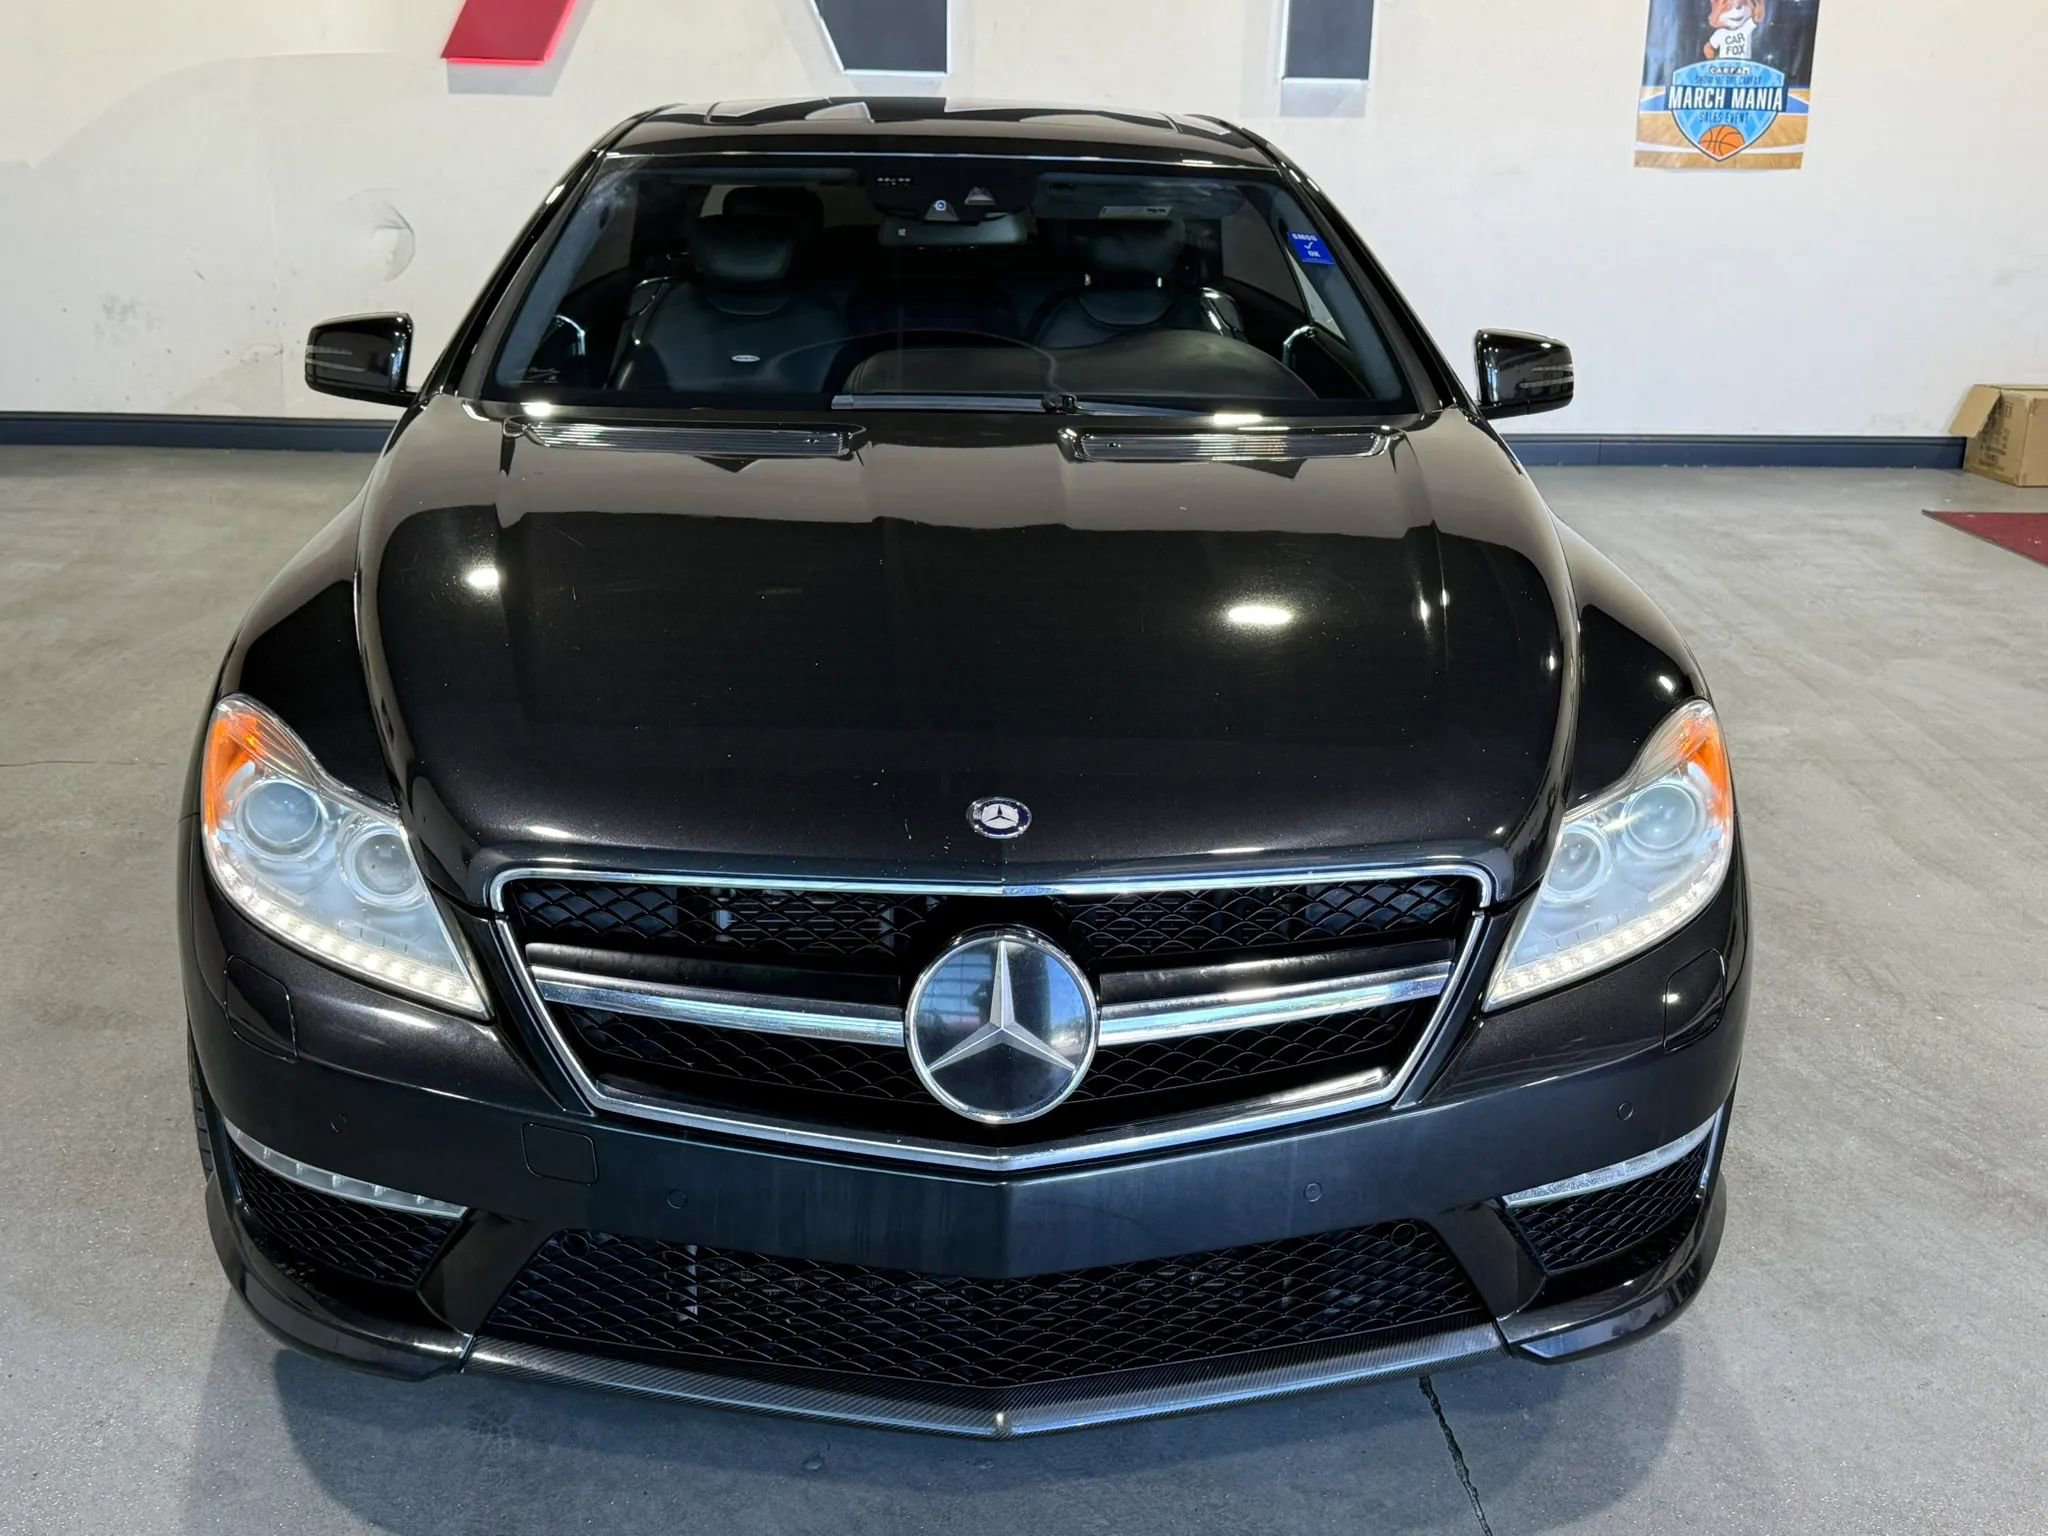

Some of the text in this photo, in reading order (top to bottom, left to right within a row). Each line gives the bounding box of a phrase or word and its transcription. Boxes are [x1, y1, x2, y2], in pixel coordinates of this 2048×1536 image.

[1724, 33, 1745, 45] CAR
[1725, 45, 1745, 56] FOX
[1668, 87, 1783, 111] MARCH MANIA
[1699, 112, 1749, 124] SALES EVENT
